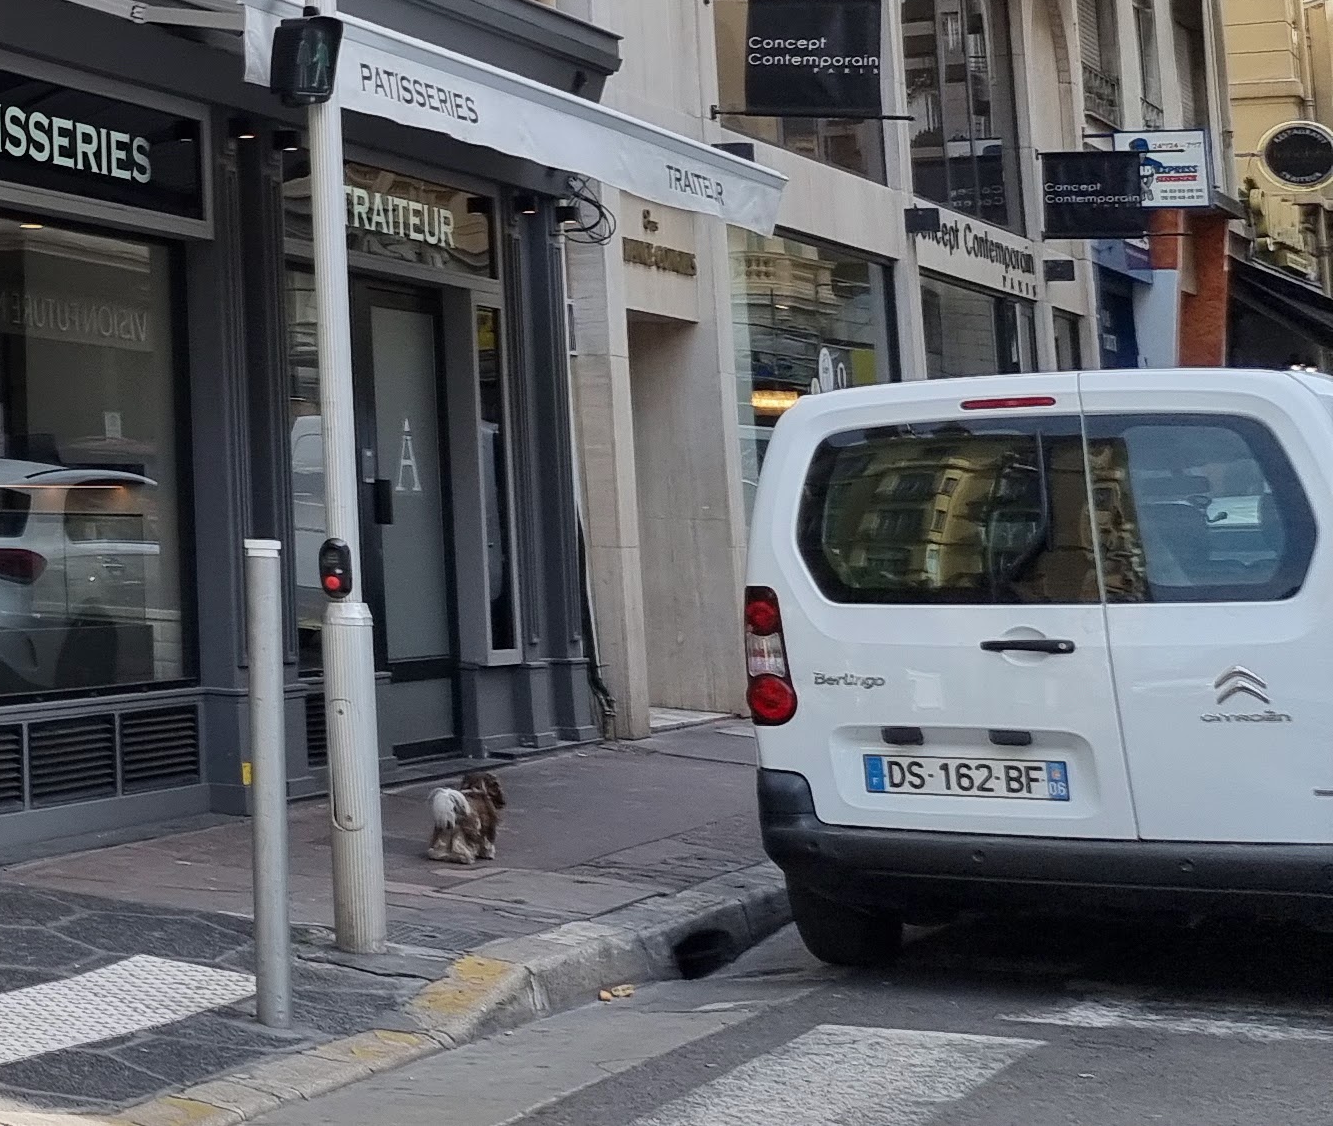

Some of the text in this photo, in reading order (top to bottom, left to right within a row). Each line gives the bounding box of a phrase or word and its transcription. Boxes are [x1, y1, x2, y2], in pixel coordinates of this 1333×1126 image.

[748, 36, 827, 51] Concept
[748, 53, 879, 69] Contemporain
[360, 61, 479, 125] PATISSERIES
[1045, 182, 1101, 192] Concept
[1045, 194, 1140, 204] Contemporain
[964, 223, 1035, 275] Contemporain
[813, 671, 886, 689] Berlingo
